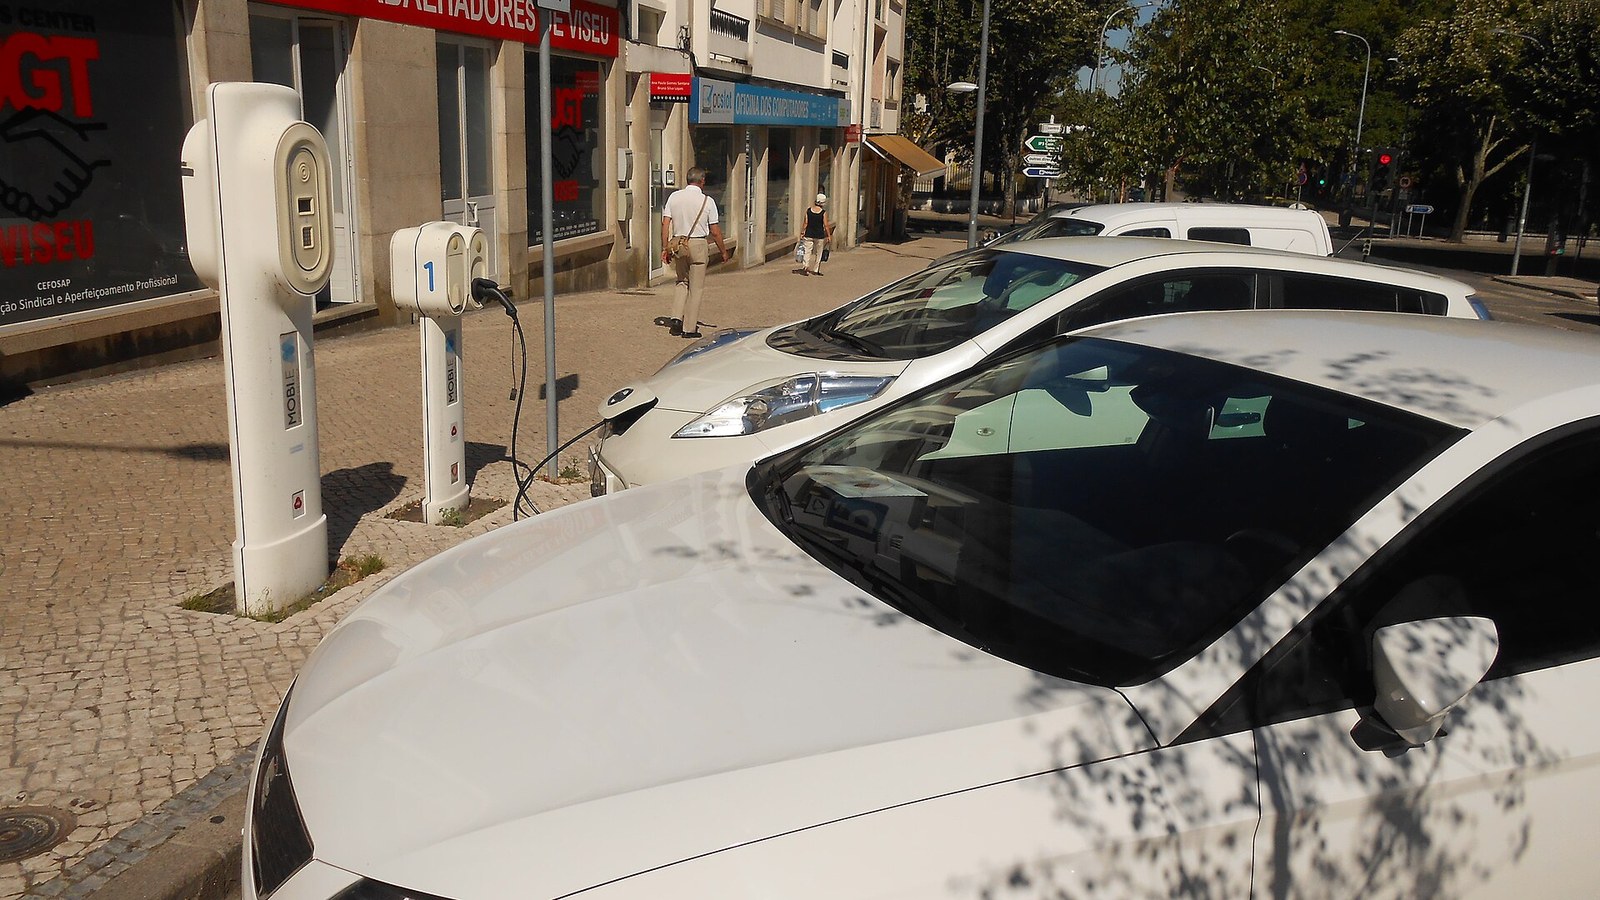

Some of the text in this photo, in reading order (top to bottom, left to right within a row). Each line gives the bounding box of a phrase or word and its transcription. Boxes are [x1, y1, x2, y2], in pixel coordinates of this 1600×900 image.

[18, 7, 96, 33] CENTER
[376, 0, 536, 32] ADORES
[568, 10, 610, 45] VISEU
[735, 92, 760, 115] OFICINA
[760, 95, 772, 116] DOS
[772, 97, 809, 119] COMPUTADORES
[0, 219, 95, 268] VISEU
[37, 278, 71, 291] CEFOSAP
[423, 261, 435, 292] 1
[19, 293, 55, 311] Sindical
[56, 296, 63, 304] e
[64, 283, 135, 304] Aperfeiçoamento
[136, 274, 178, 291] Profissional
